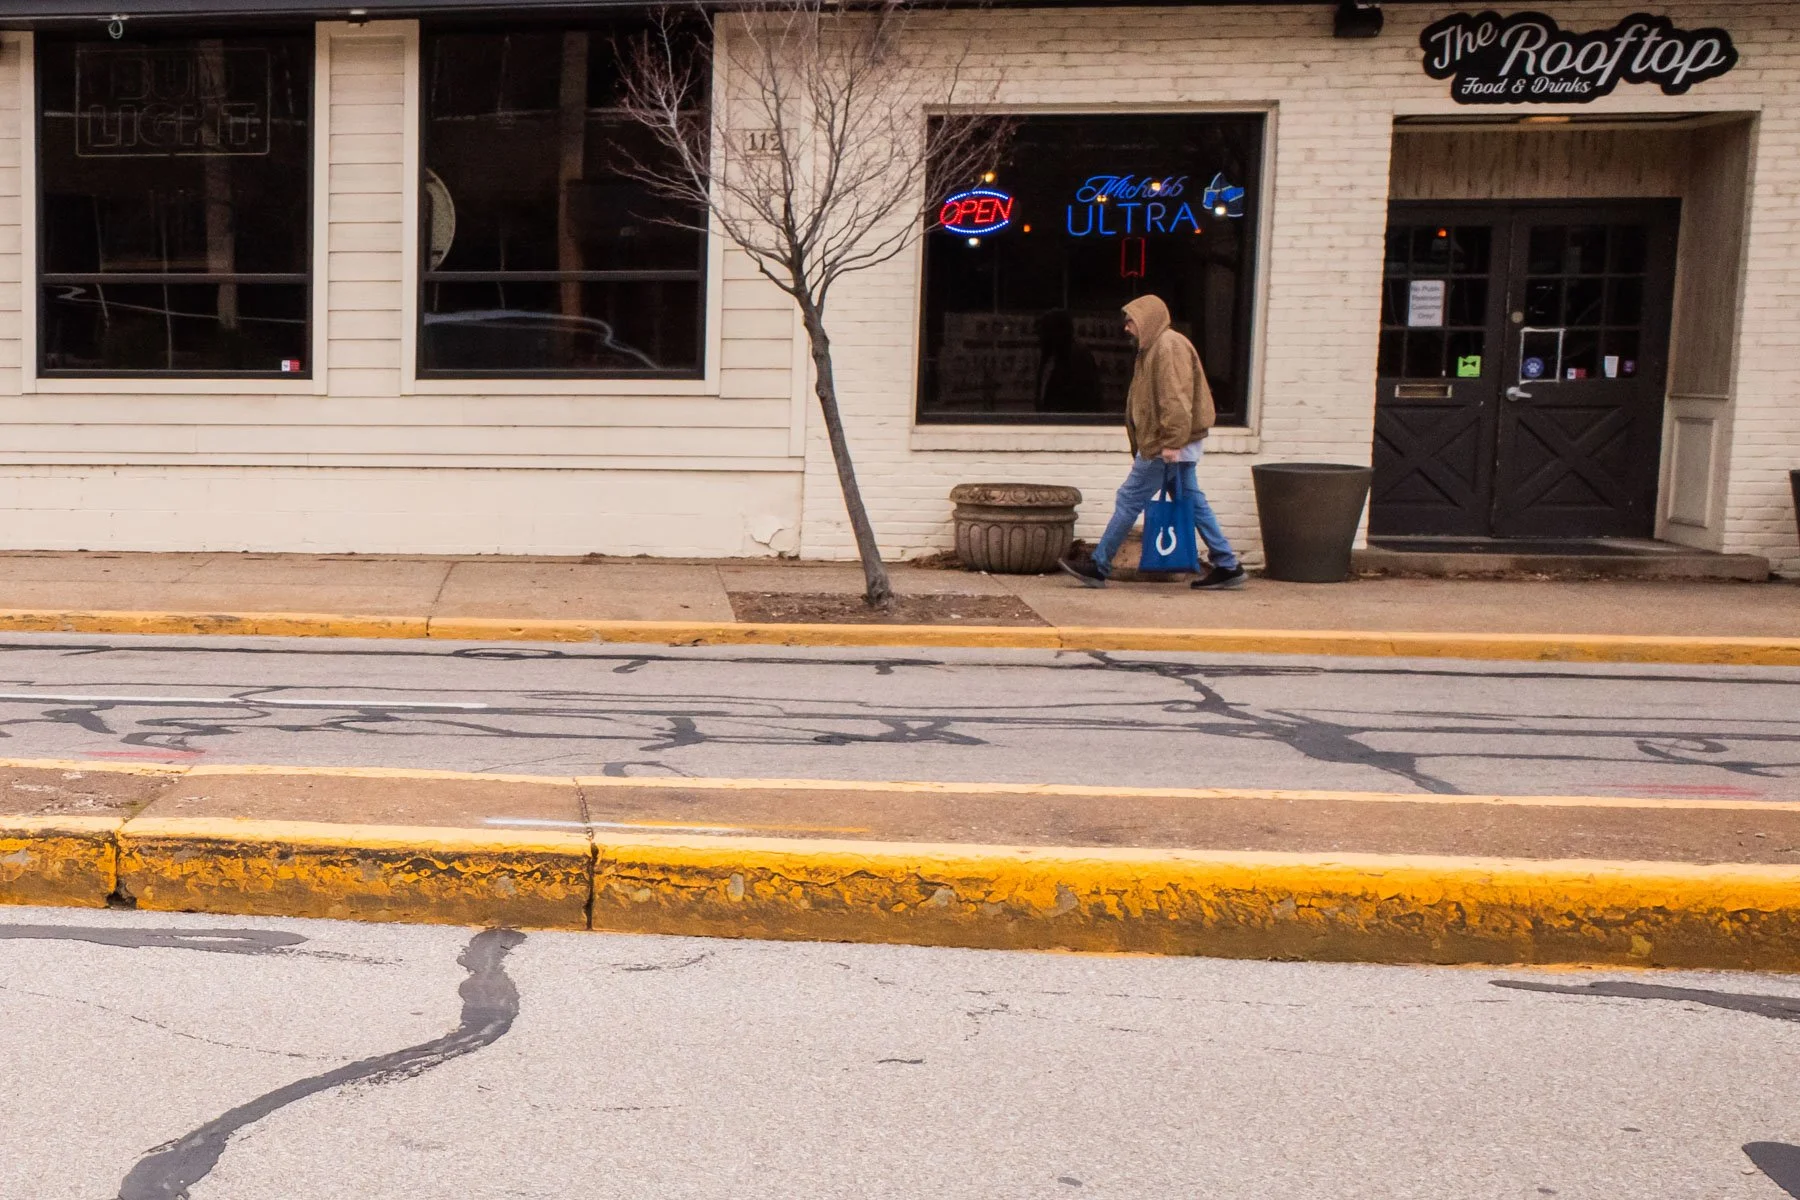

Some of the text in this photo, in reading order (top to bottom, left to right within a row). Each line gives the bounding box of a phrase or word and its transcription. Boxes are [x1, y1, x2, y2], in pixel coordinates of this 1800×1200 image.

[1430, 20, 1727, 86] The Rooftop
[1461, 76, 1592, 95] Food & Drinks
[748, 132, 783, 151] 112
[940, 196, 1014, 226] OPEN
[1066, 202, 1201, 237] ULTRA
